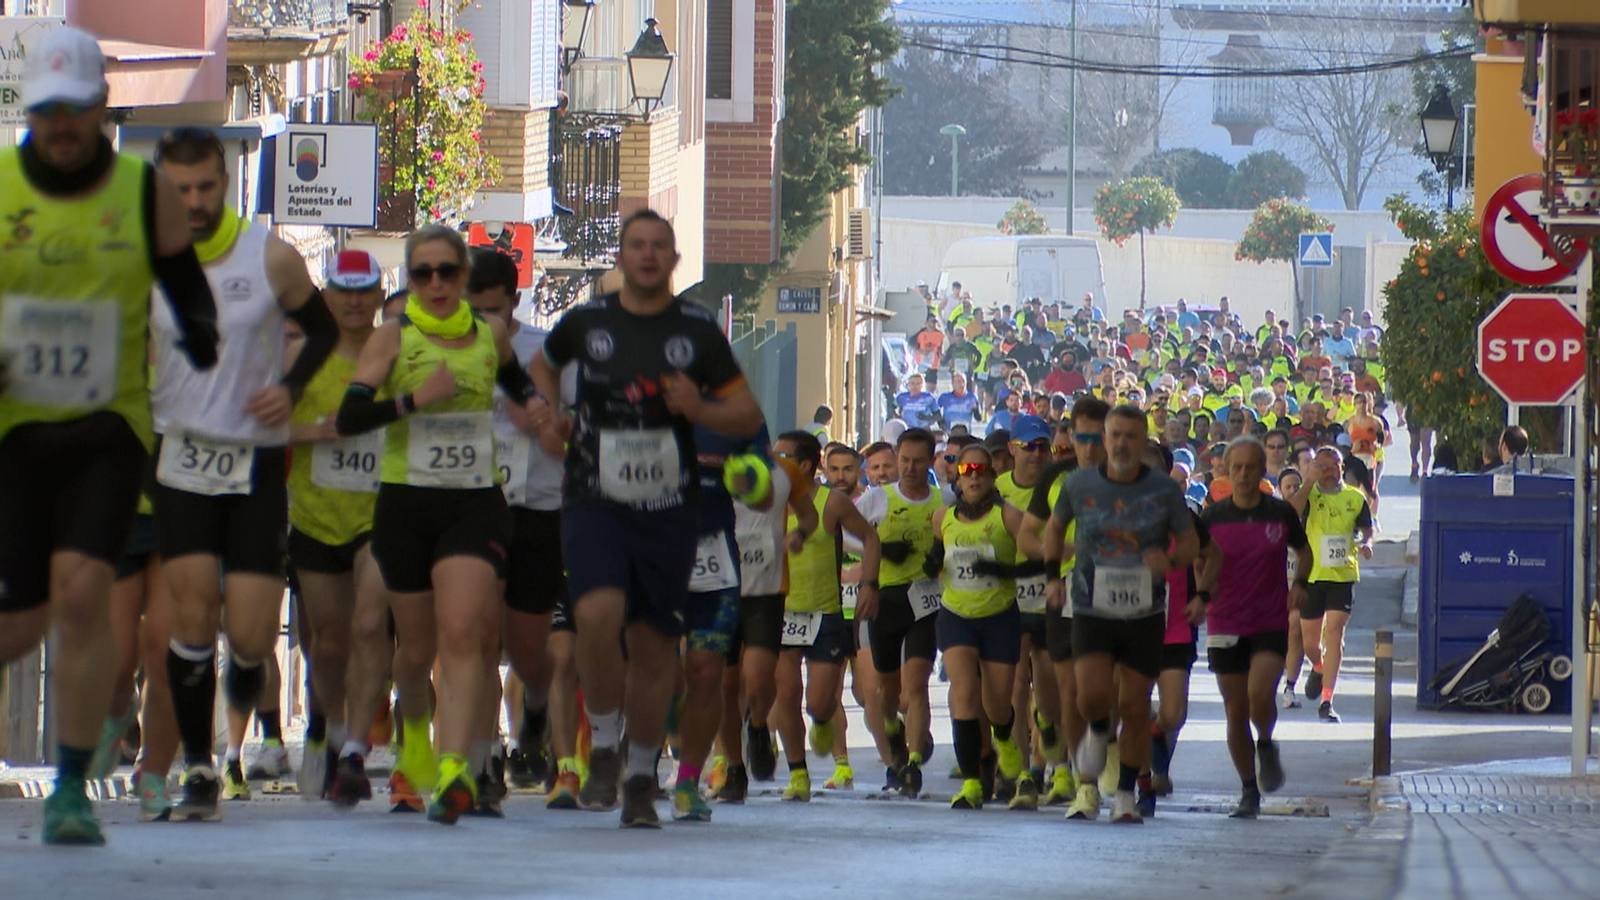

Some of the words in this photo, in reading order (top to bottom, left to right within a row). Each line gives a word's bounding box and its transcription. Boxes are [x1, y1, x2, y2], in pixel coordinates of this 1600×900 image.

[331, 187, 337, 195] y
[288, 195, 334, 206] Apuestas
[337, 197, 352, 206] del
[288, 207, 322, 216] Estado
[1487, 339, 1581, 362] STOP
[25, 344, 90, 377] 312
[181, 446, 234, 477] 370
[330, 451, 375, 474] 340
[429, 445, 476, 469] 259
[618, 462, 664, 482] 466
[1329, 548, 1346, 559] 280
[957, 566, 979, 580] 29
[1017, 583, 1046, 600] 242
